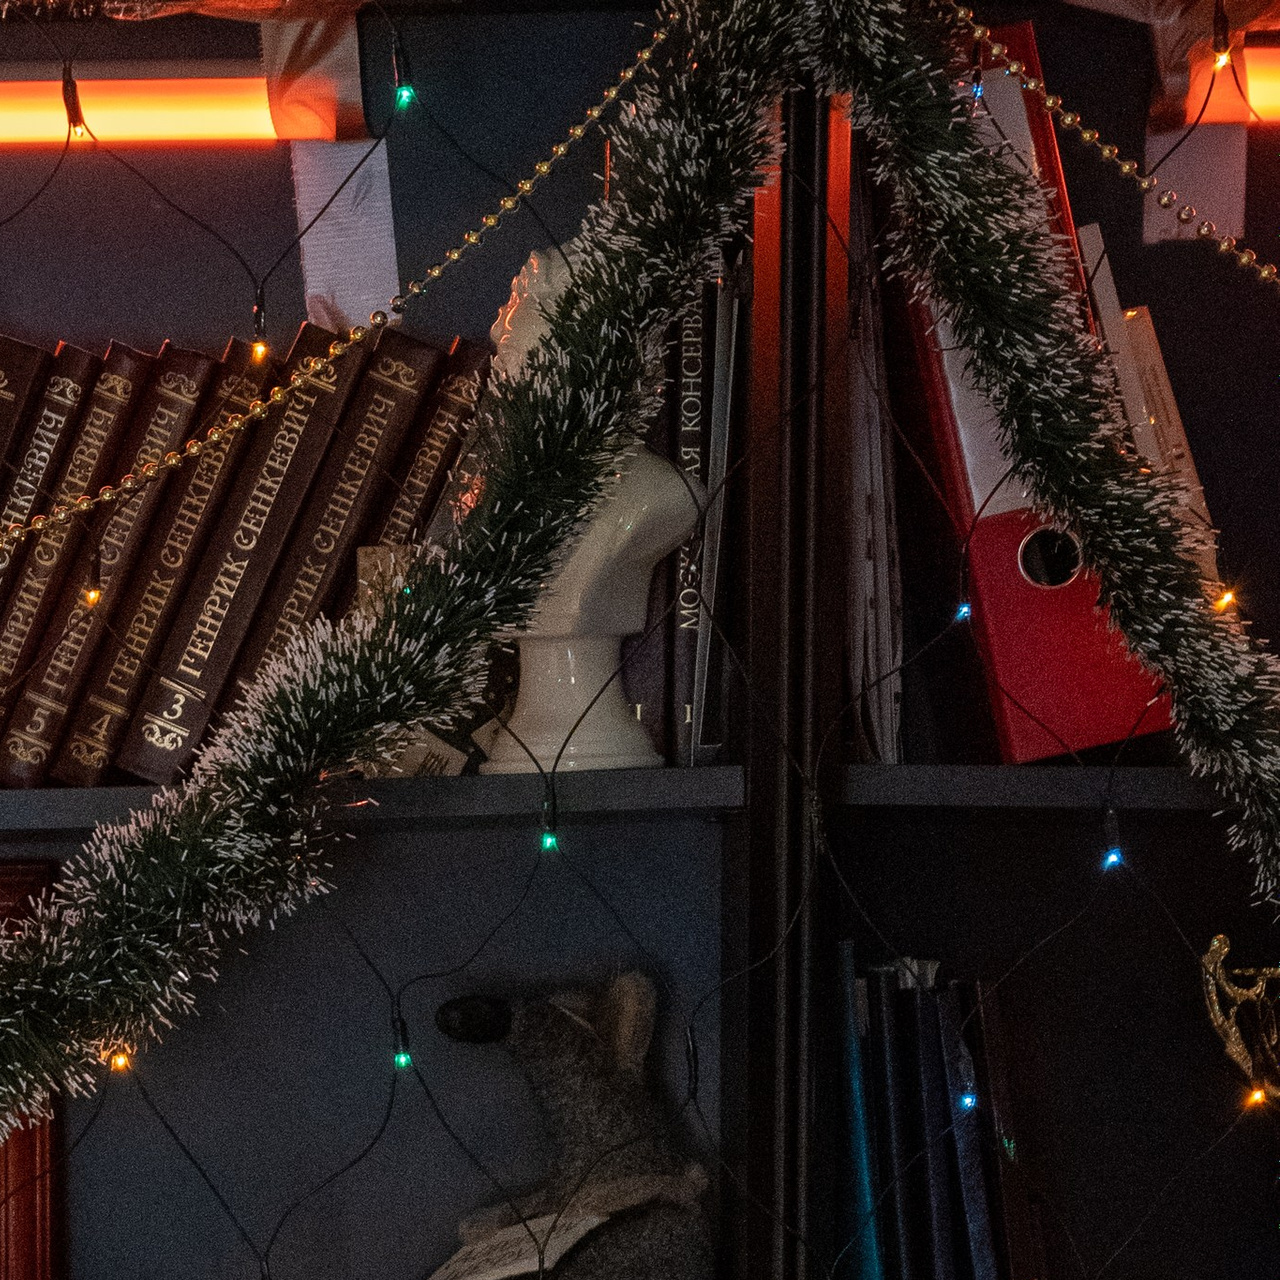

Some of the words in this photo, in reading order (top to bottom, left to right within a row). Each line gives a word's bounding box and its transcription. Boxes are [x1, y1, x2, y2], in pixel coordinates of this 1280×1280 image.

[175, 550, 252, 680] ГЕНРИК
[227, 387, 322, 553] СЕНКЕВИЧ
[306, 391, 399, 557] СЕНКЕВИЧ
[376, 403, 463, 554] ЕНКЕВИЧ
[102, 568, 179, 697] ГЕНРИК
[26, 706, 49, 735] 5
[90, 710, 111, 739] 4
[164, 692, 186, 721] 3
